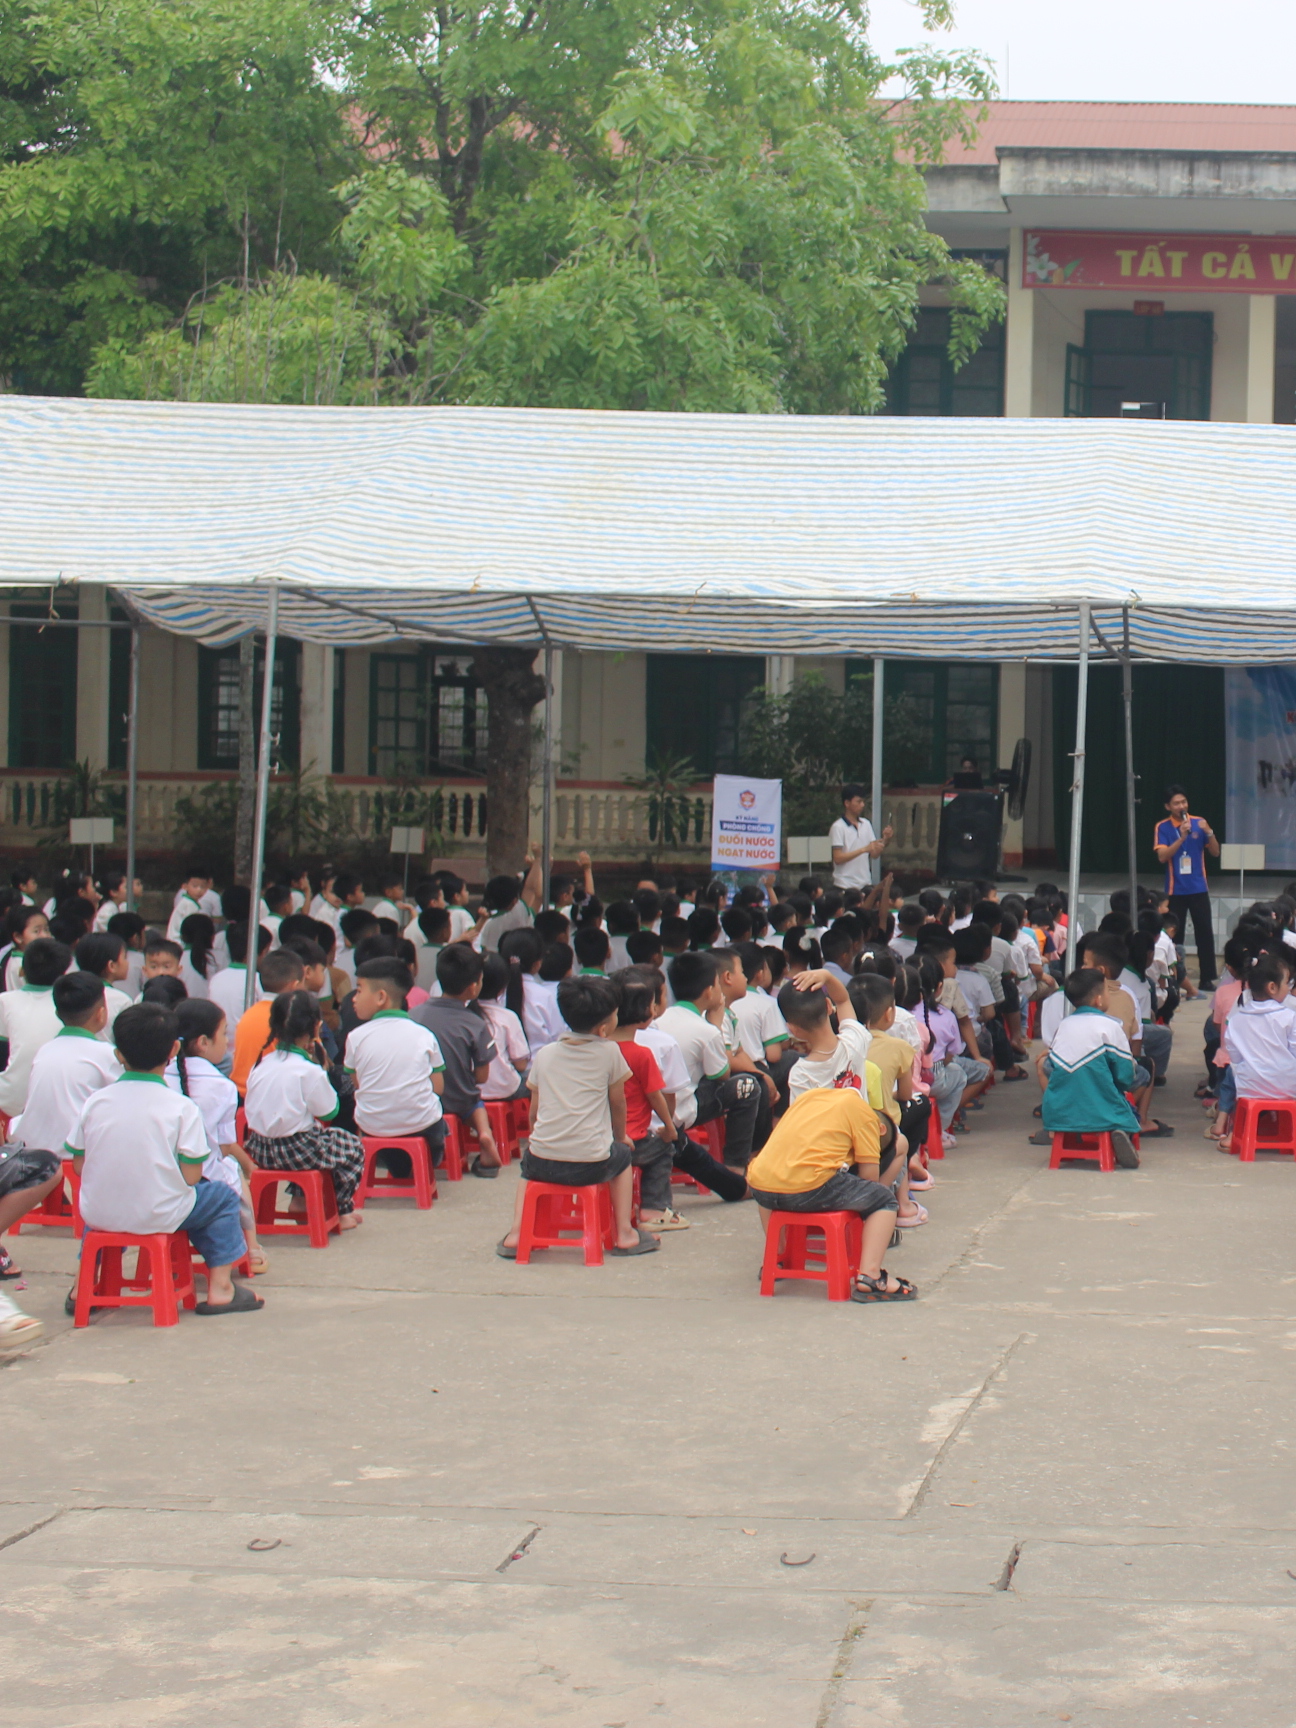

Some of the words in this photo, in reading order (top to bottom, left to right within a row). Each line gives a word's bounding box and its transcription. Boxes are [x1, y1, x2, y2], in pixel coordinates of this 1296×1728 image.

[1116, 241, 1188, 278] TẤT
[1201, 244, 1257, 279] CẢ
[723, 822, 746, 831] PHÒNG
[747, 823, 771, 832] CHỐNG
[719, 833, 744, 845] ĐUỐI
[745, 836, 775, 847] NƯỚC
[718, 848, 745, 860] NGẠT
[746, 849, 775, 859] NƯỚC
